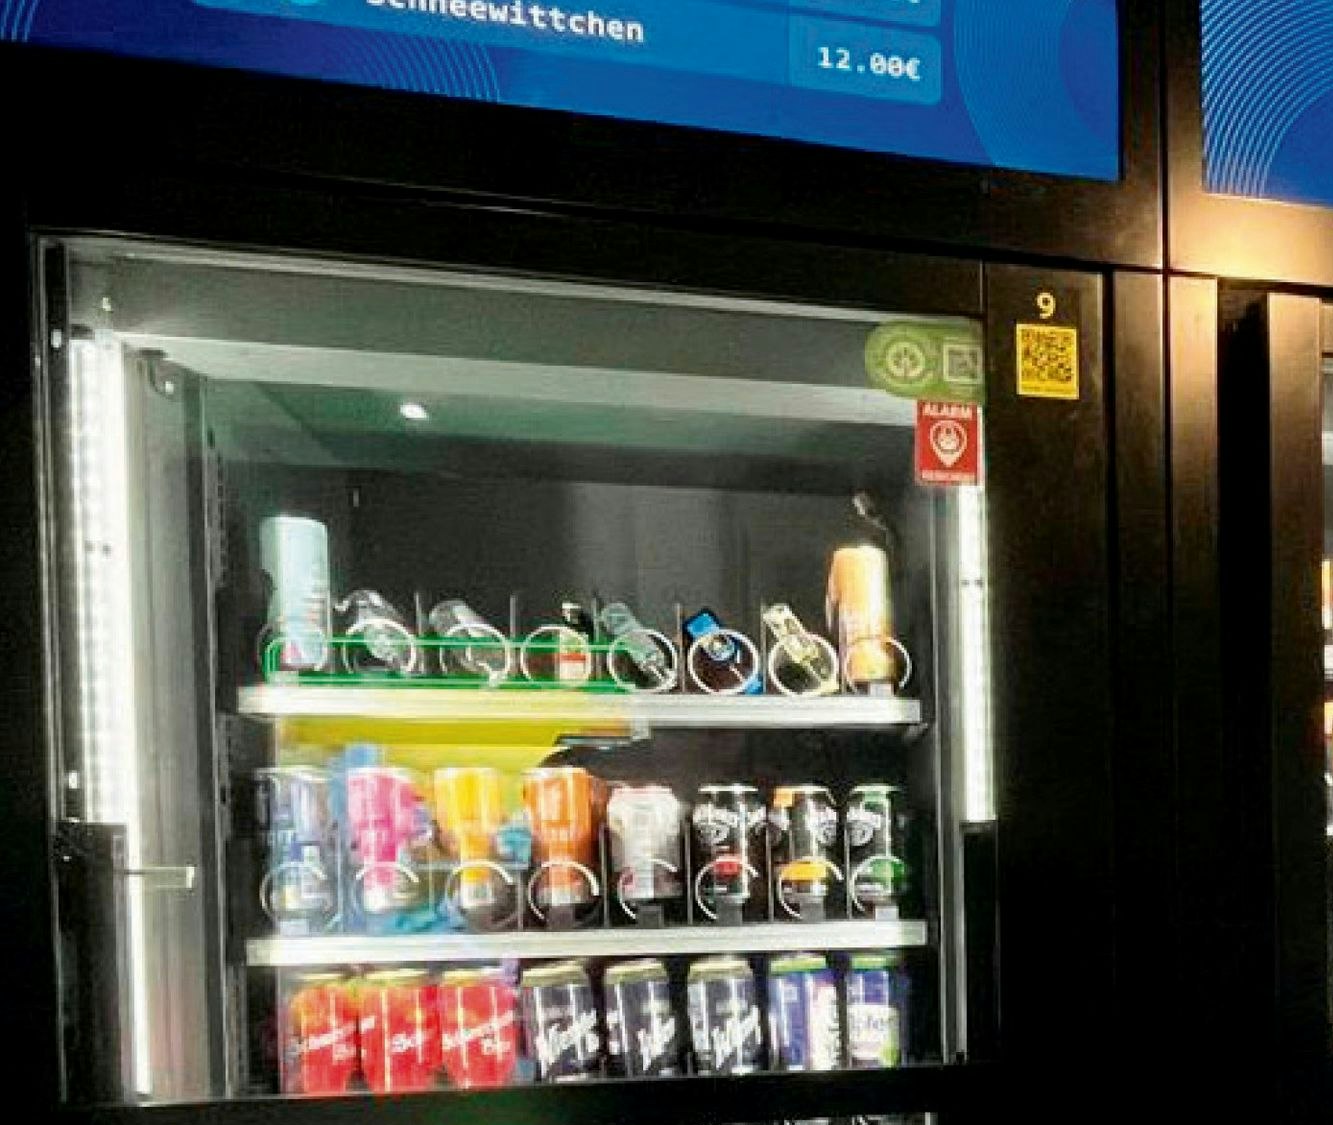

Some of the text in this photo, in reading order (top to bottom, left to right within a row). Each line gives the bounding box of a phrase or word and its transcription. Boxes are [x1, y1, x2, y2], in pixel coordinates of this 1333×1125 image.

[366, 0, 644, 43] neewittchen
[817, 46, 920, 82] 12.00€
[1036, 292, 1056, 320] 9
